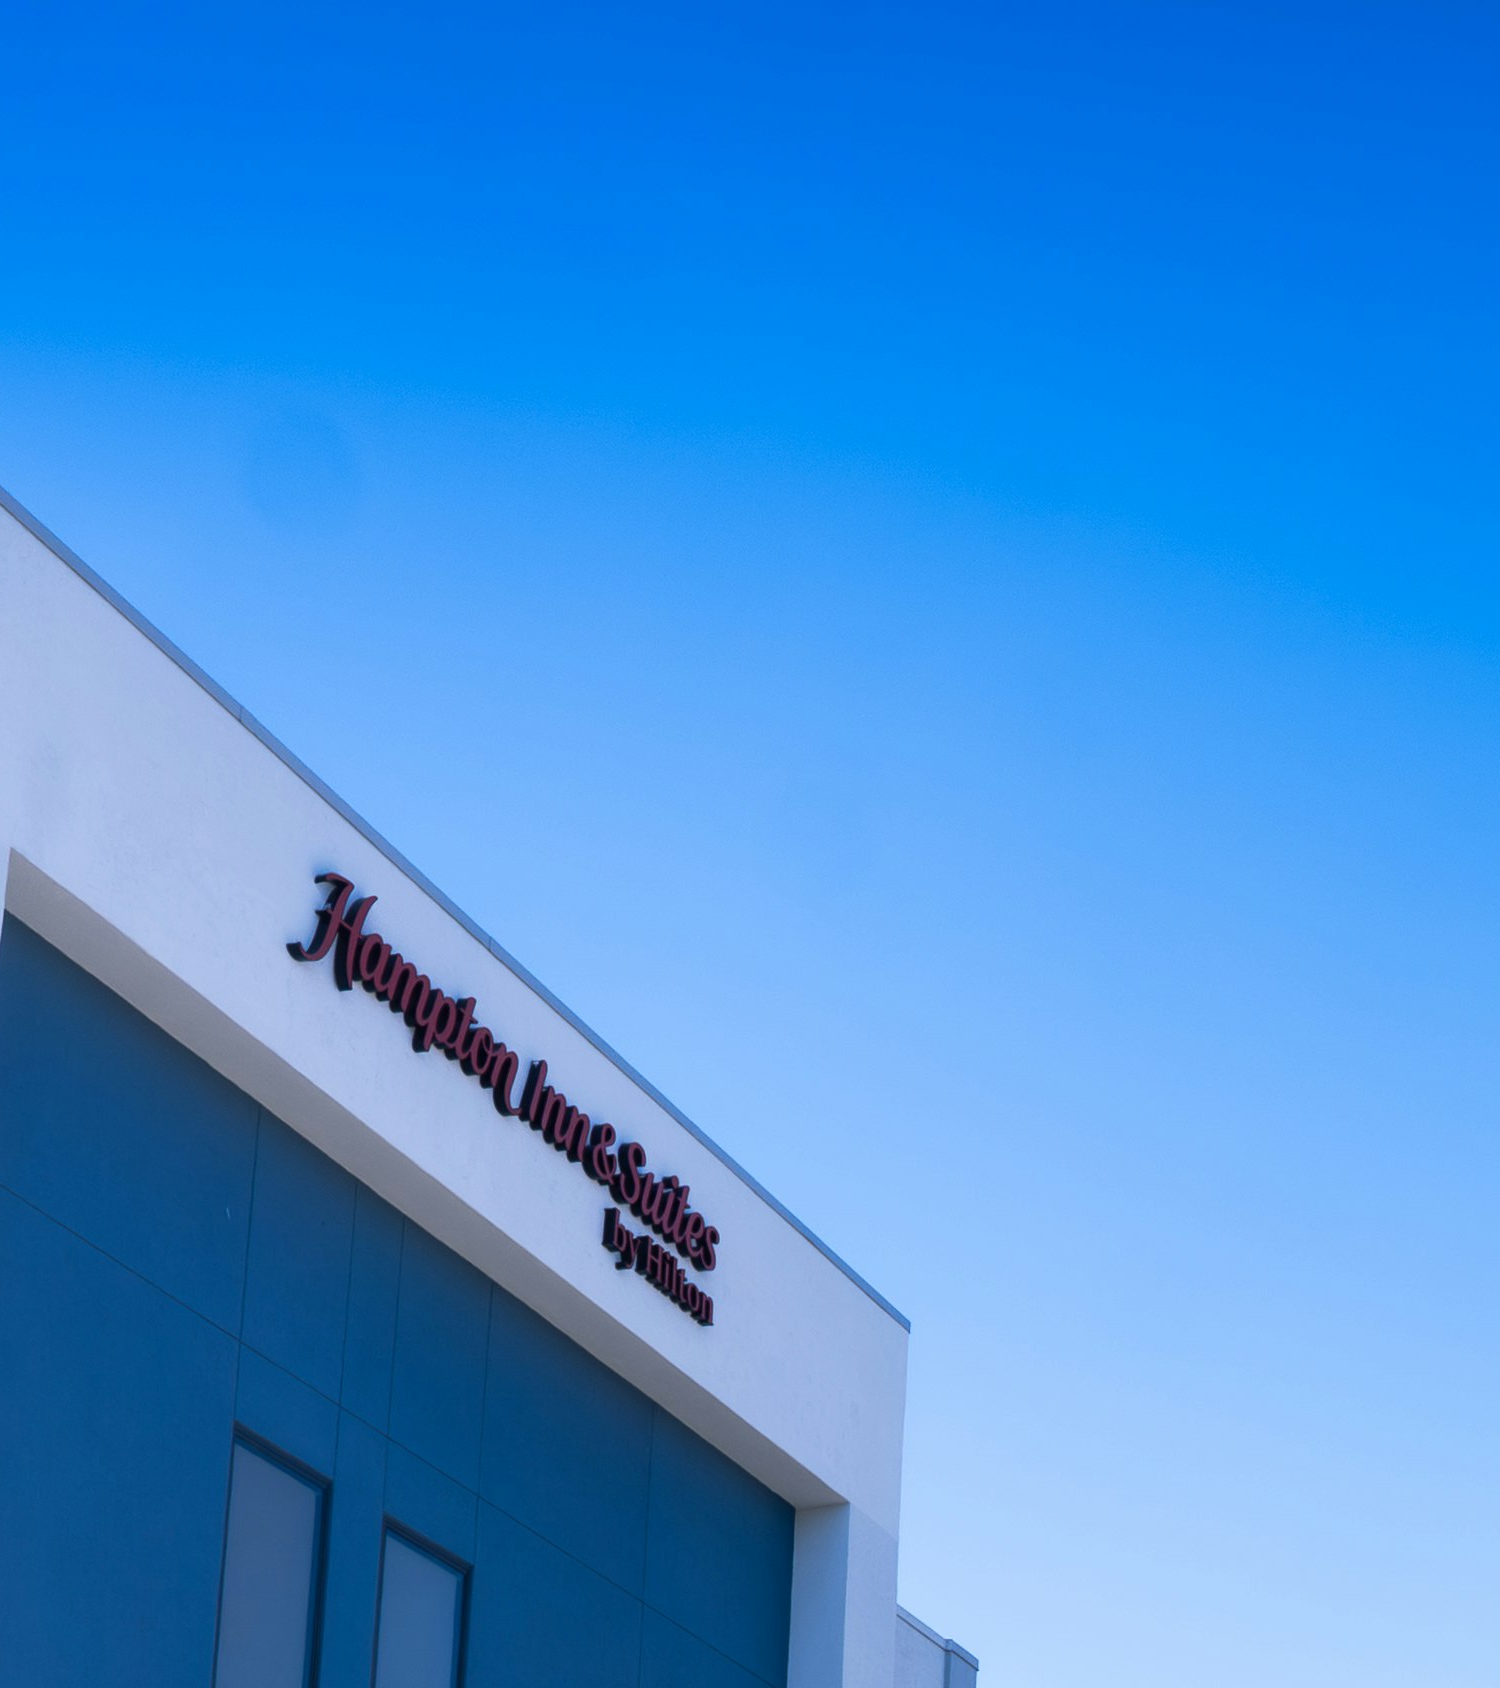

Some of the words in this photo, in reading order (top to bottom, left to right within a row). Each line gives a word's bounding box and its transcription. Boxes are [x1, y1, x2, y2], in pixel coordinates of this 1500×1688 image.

[286, 872, 521, 1116] Hampton
[519, 1060, 590, 1162] Inn
[610, 1142, 720, 1271] Suites
[602, 1207, 641, 1270] by
[635, 1235, 714, 1327] Hilton
